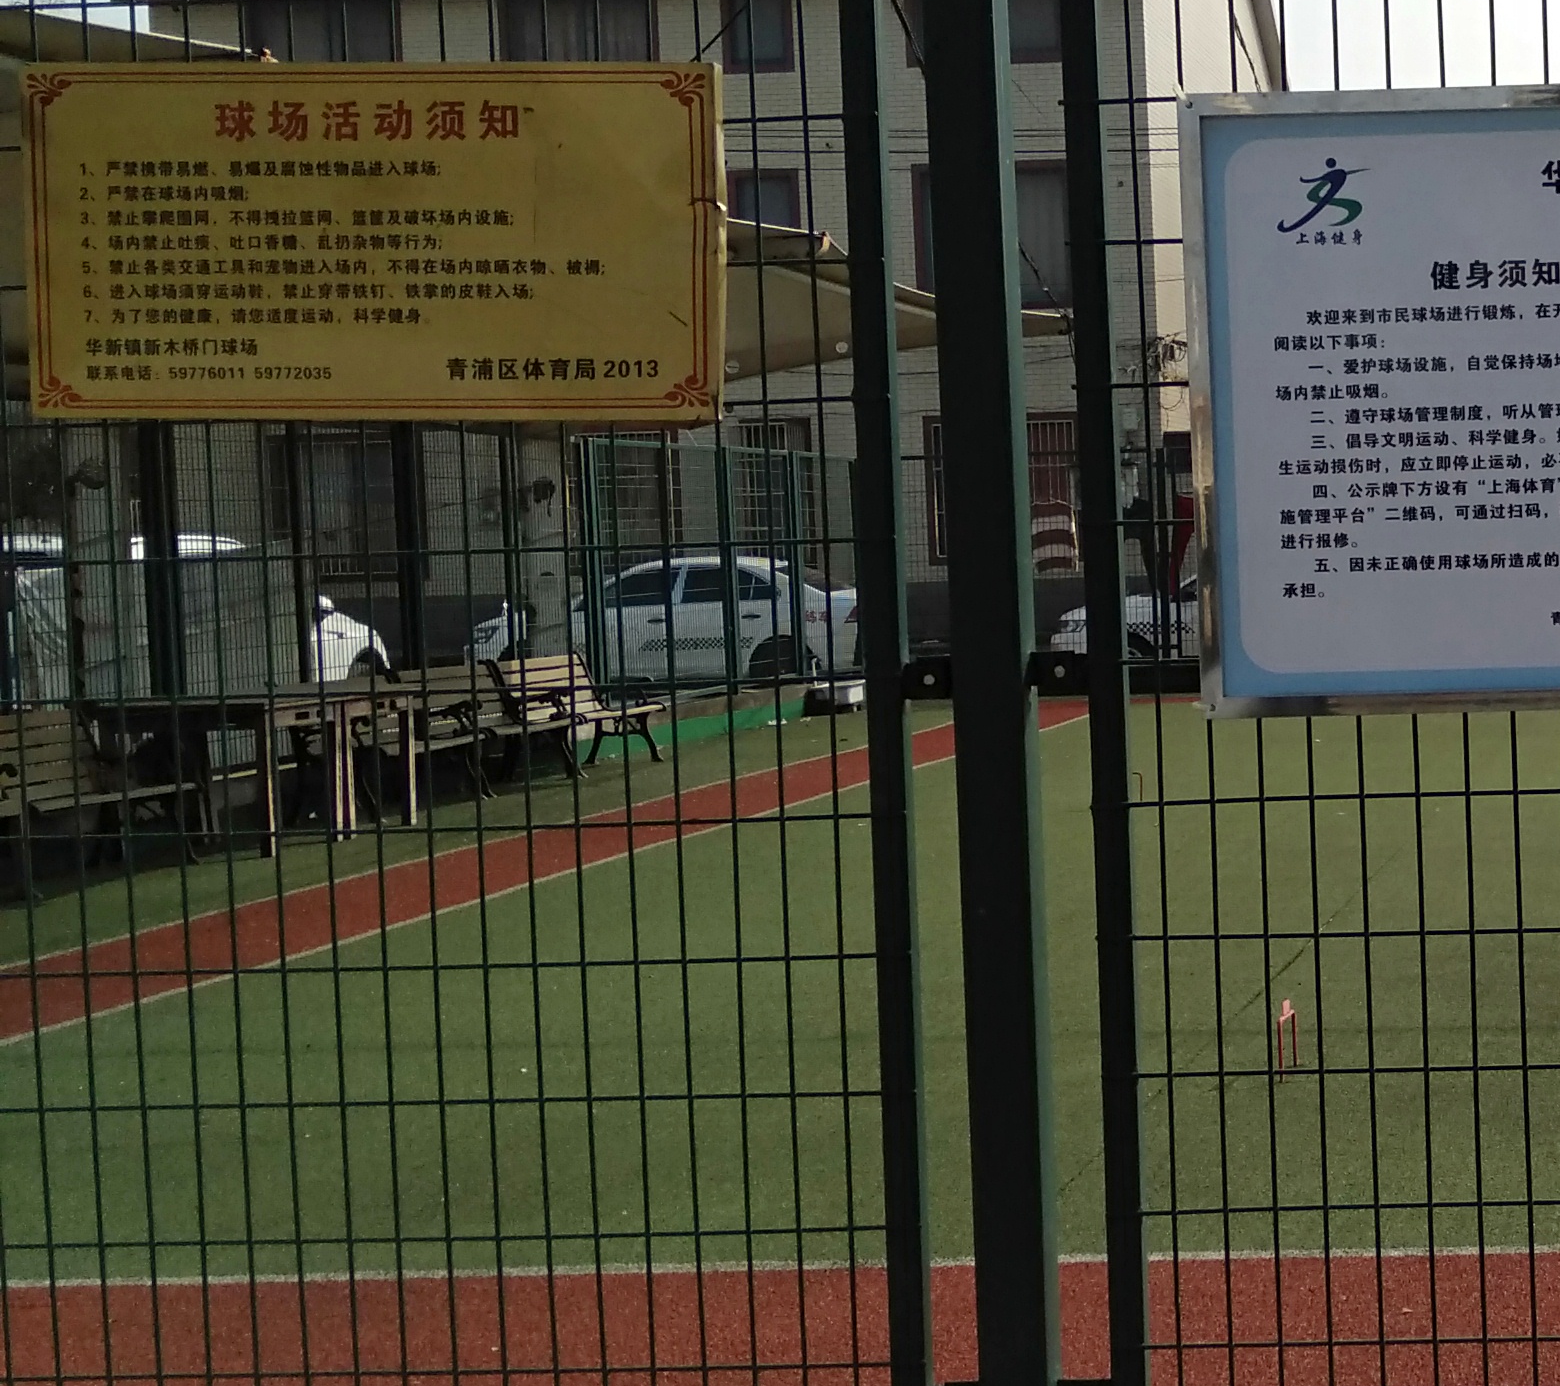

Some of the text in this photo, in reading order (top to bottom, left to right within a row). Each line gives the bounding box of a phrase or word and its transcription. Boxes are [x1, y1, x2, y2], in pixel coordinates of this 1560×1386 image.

[214, 100, 519, 142] 球场活动须知
[1296, 229, 1364, 245] 上海健身
[1430, 258, 1560, 291] 健身须知
[86, 338, 258, 356] 华新镇新木桥门球场
[1274, 334, 1386, 351] 阅读以下事项：
[254, 366, 332, 380] 59772035
[446, 358, 659, 380] 青浦区体育局 2013
[1275, 383, 1388, 401] 场内禁止吸烟。
[1280, 533, 1358, 549] 进行报修。
[1282, 582, 1325, 599] 承担。
